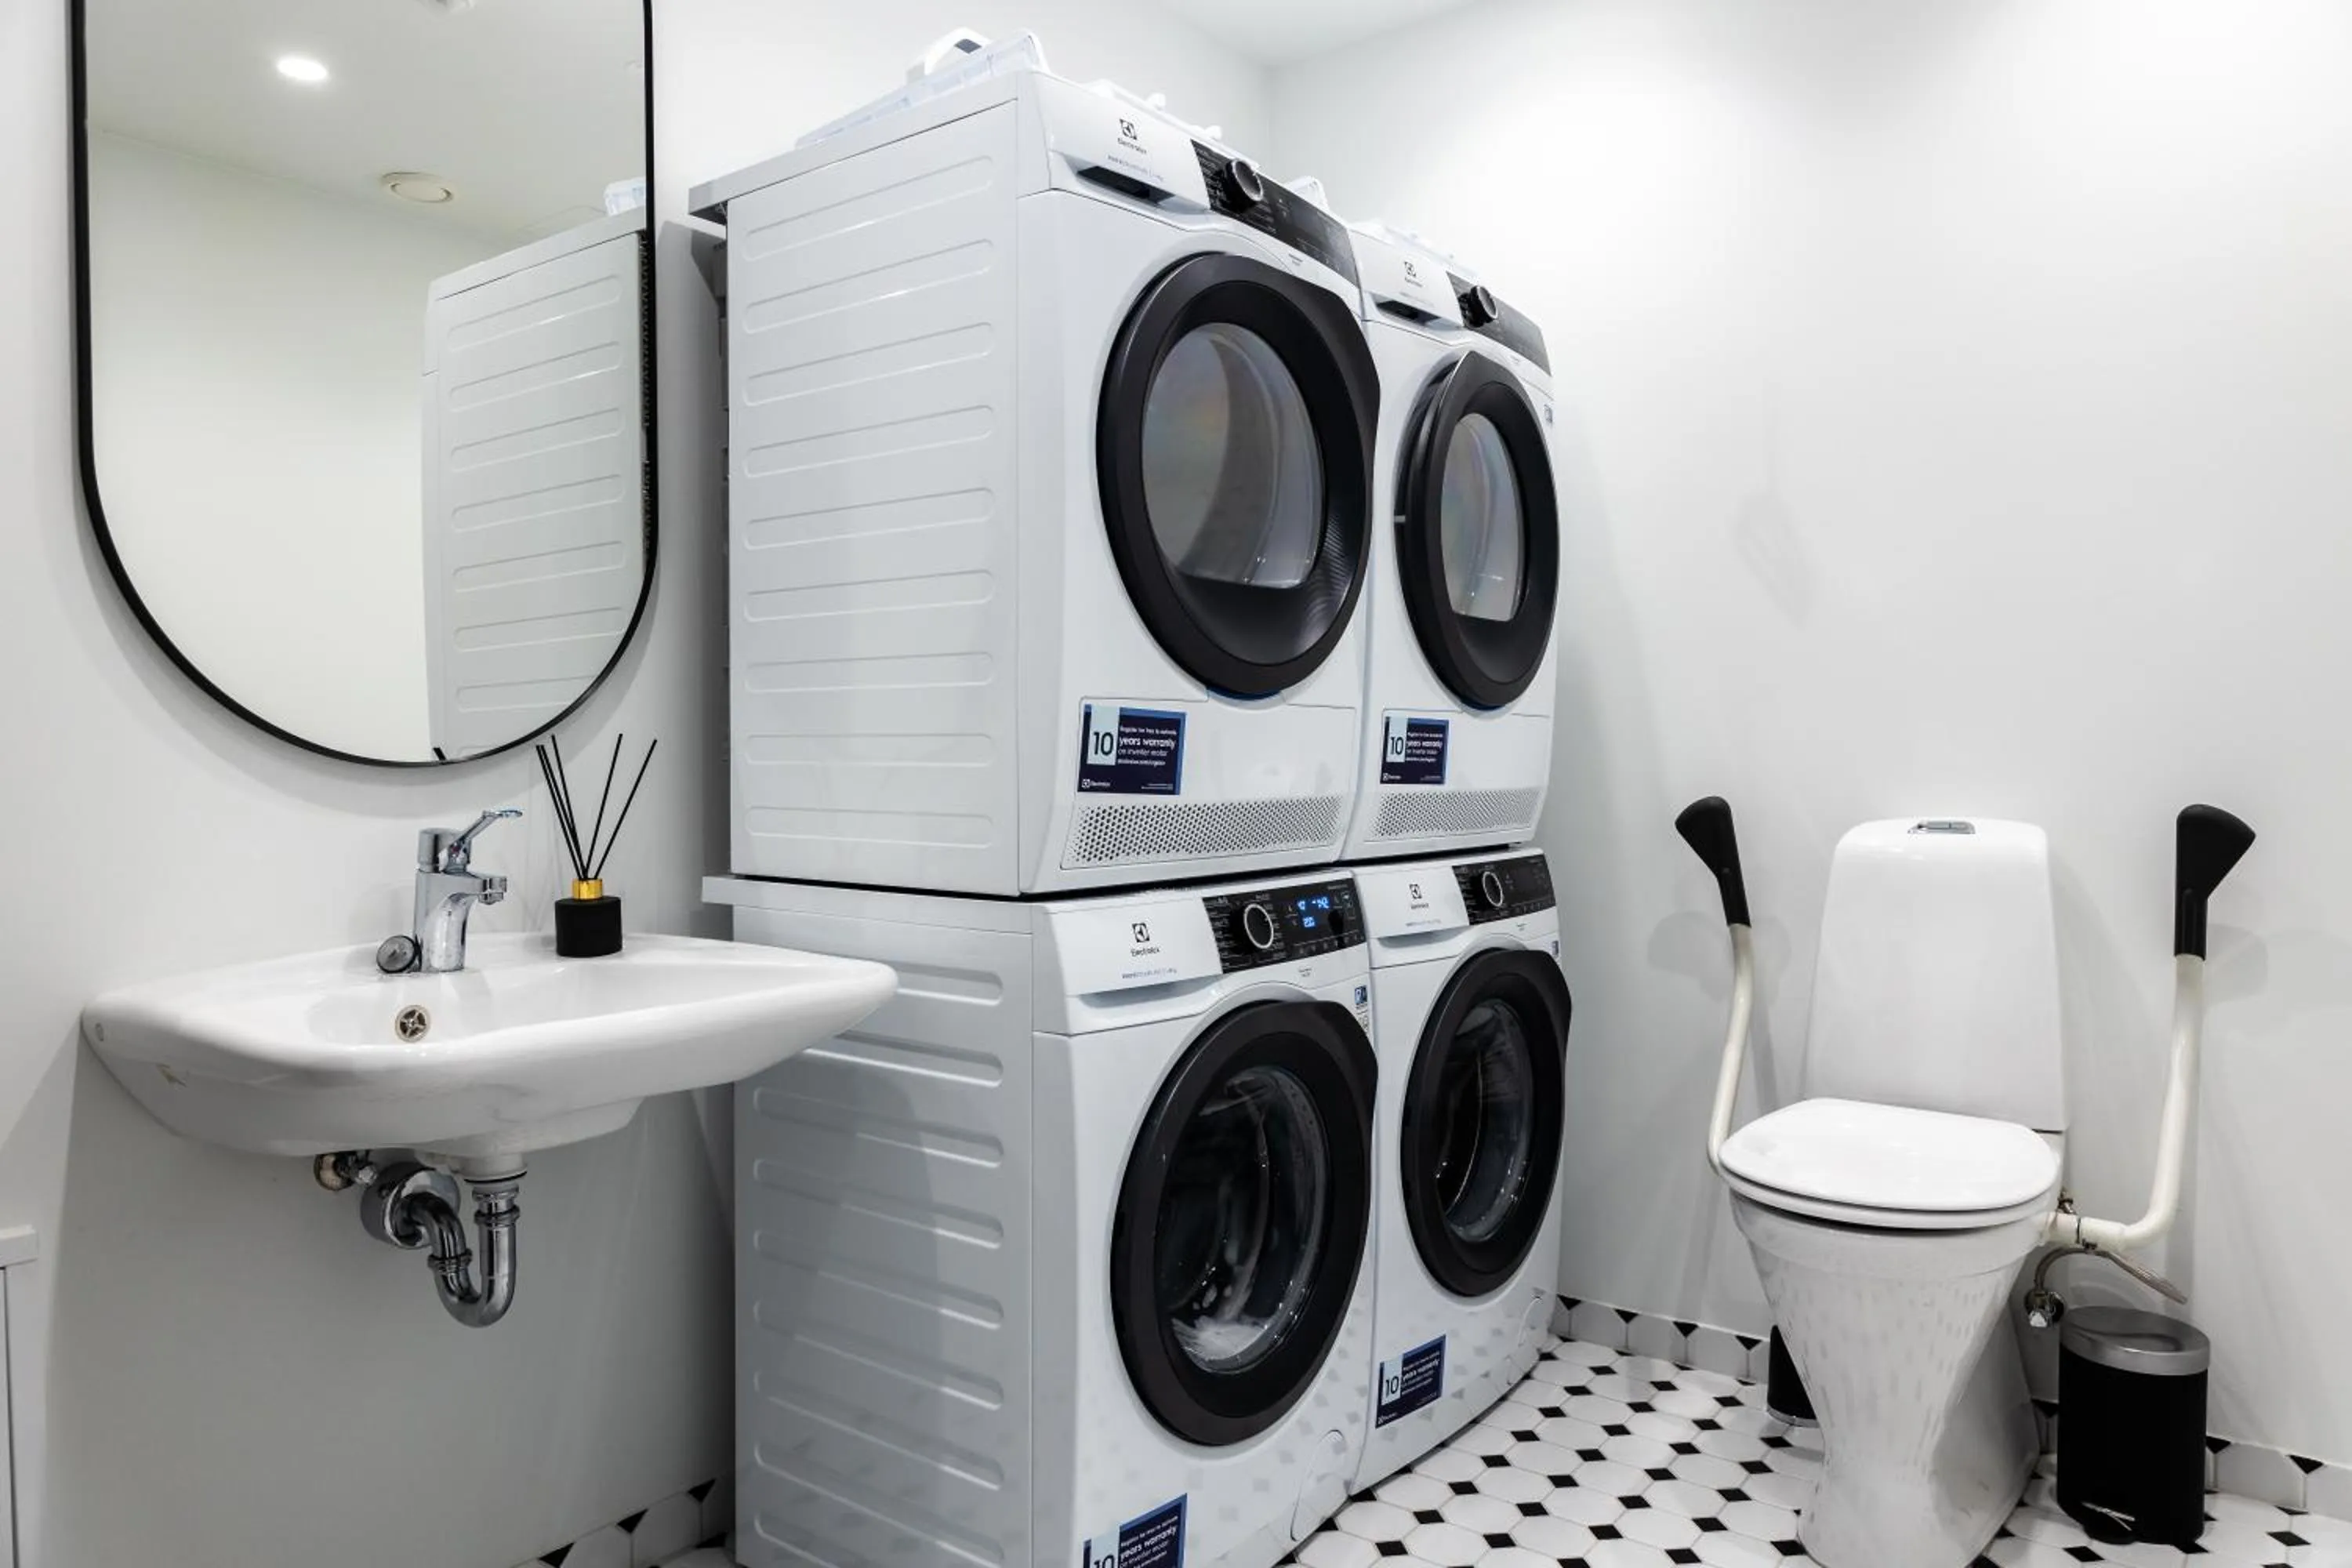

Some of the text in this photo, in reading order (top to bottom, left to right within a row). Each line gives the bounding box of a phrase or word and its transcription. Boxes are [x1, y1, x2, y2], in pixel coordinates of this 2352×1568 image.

[1094, 731, 1114, 756] 10
[1119, 737, 1141, 746] years
[1391, 736, 1404, 755] 10
[1385, 1376, 1399, 1398] 10
